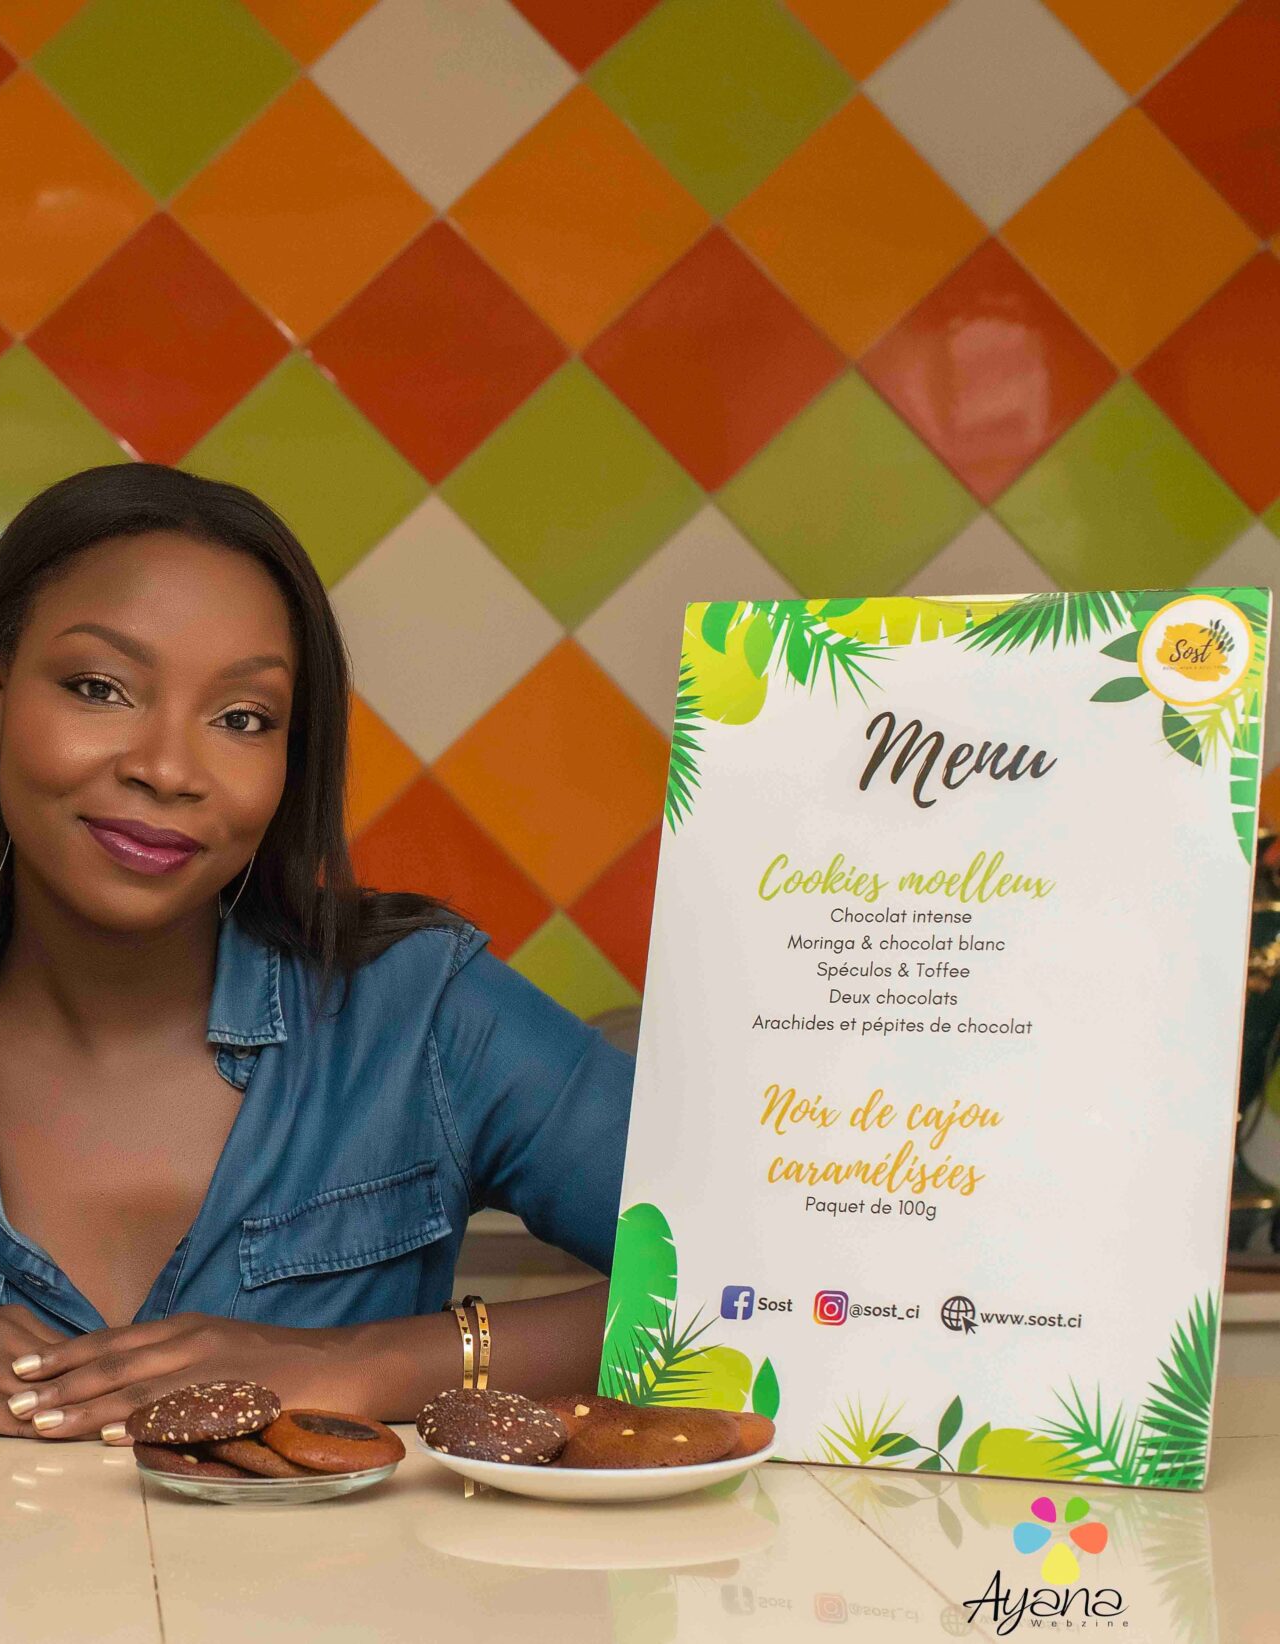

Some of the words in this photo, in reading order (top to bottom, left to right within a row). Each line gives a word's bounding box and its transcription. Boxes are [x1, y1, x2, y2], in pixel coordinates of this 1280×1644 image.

[1169, 638, 1213, 664] Sost
[858, 711, 1058, 809] Menu
[757, 852, 888, 904] Cookies
[897, 850, 1056, 904] moelleux
[830, 906, 908, 924] Chocolat
[912, 909, 973, 924] intense
[787, 934, 855, 955] Moringa
[861, 934, 873, 950] &
[879, 933, 954, 951] chocolat
[958, 934, 1006, 952] blanc
[816, 960, 892, 981] Spéculos
[897, 962, 910, 978] &
[916, 961, 971, 979] Toffee
[829, 988, 871, 1005] Deux
[876, 988, 958, 1006] chocolats
[751, 1013, 835, 1031] Arachides
[839, 1017, 857, 1031] et
[861, 1016, 924, 1037] pépites
[929, 1016, 952, 1033] de
[957, 1016, 1033, 1035] chocolat
[759, 1083, 841, 1136] Noix
[849, 1088, 897, 1132] de
[906, 1100, 1005, 1151] cajou
[767, 1139, 985, 1197] caramélisées
[805, 1196, 866, 1218] Paquet
[870, 1197, 892, 1215] de
[898, 1199, 937, 1222] 100g
[757, 1297, 793, 1313] Sost
[848, 1303, 920, 1321] @sost_ci
[979, 1312, 1083, 1329] www.sost.ci
